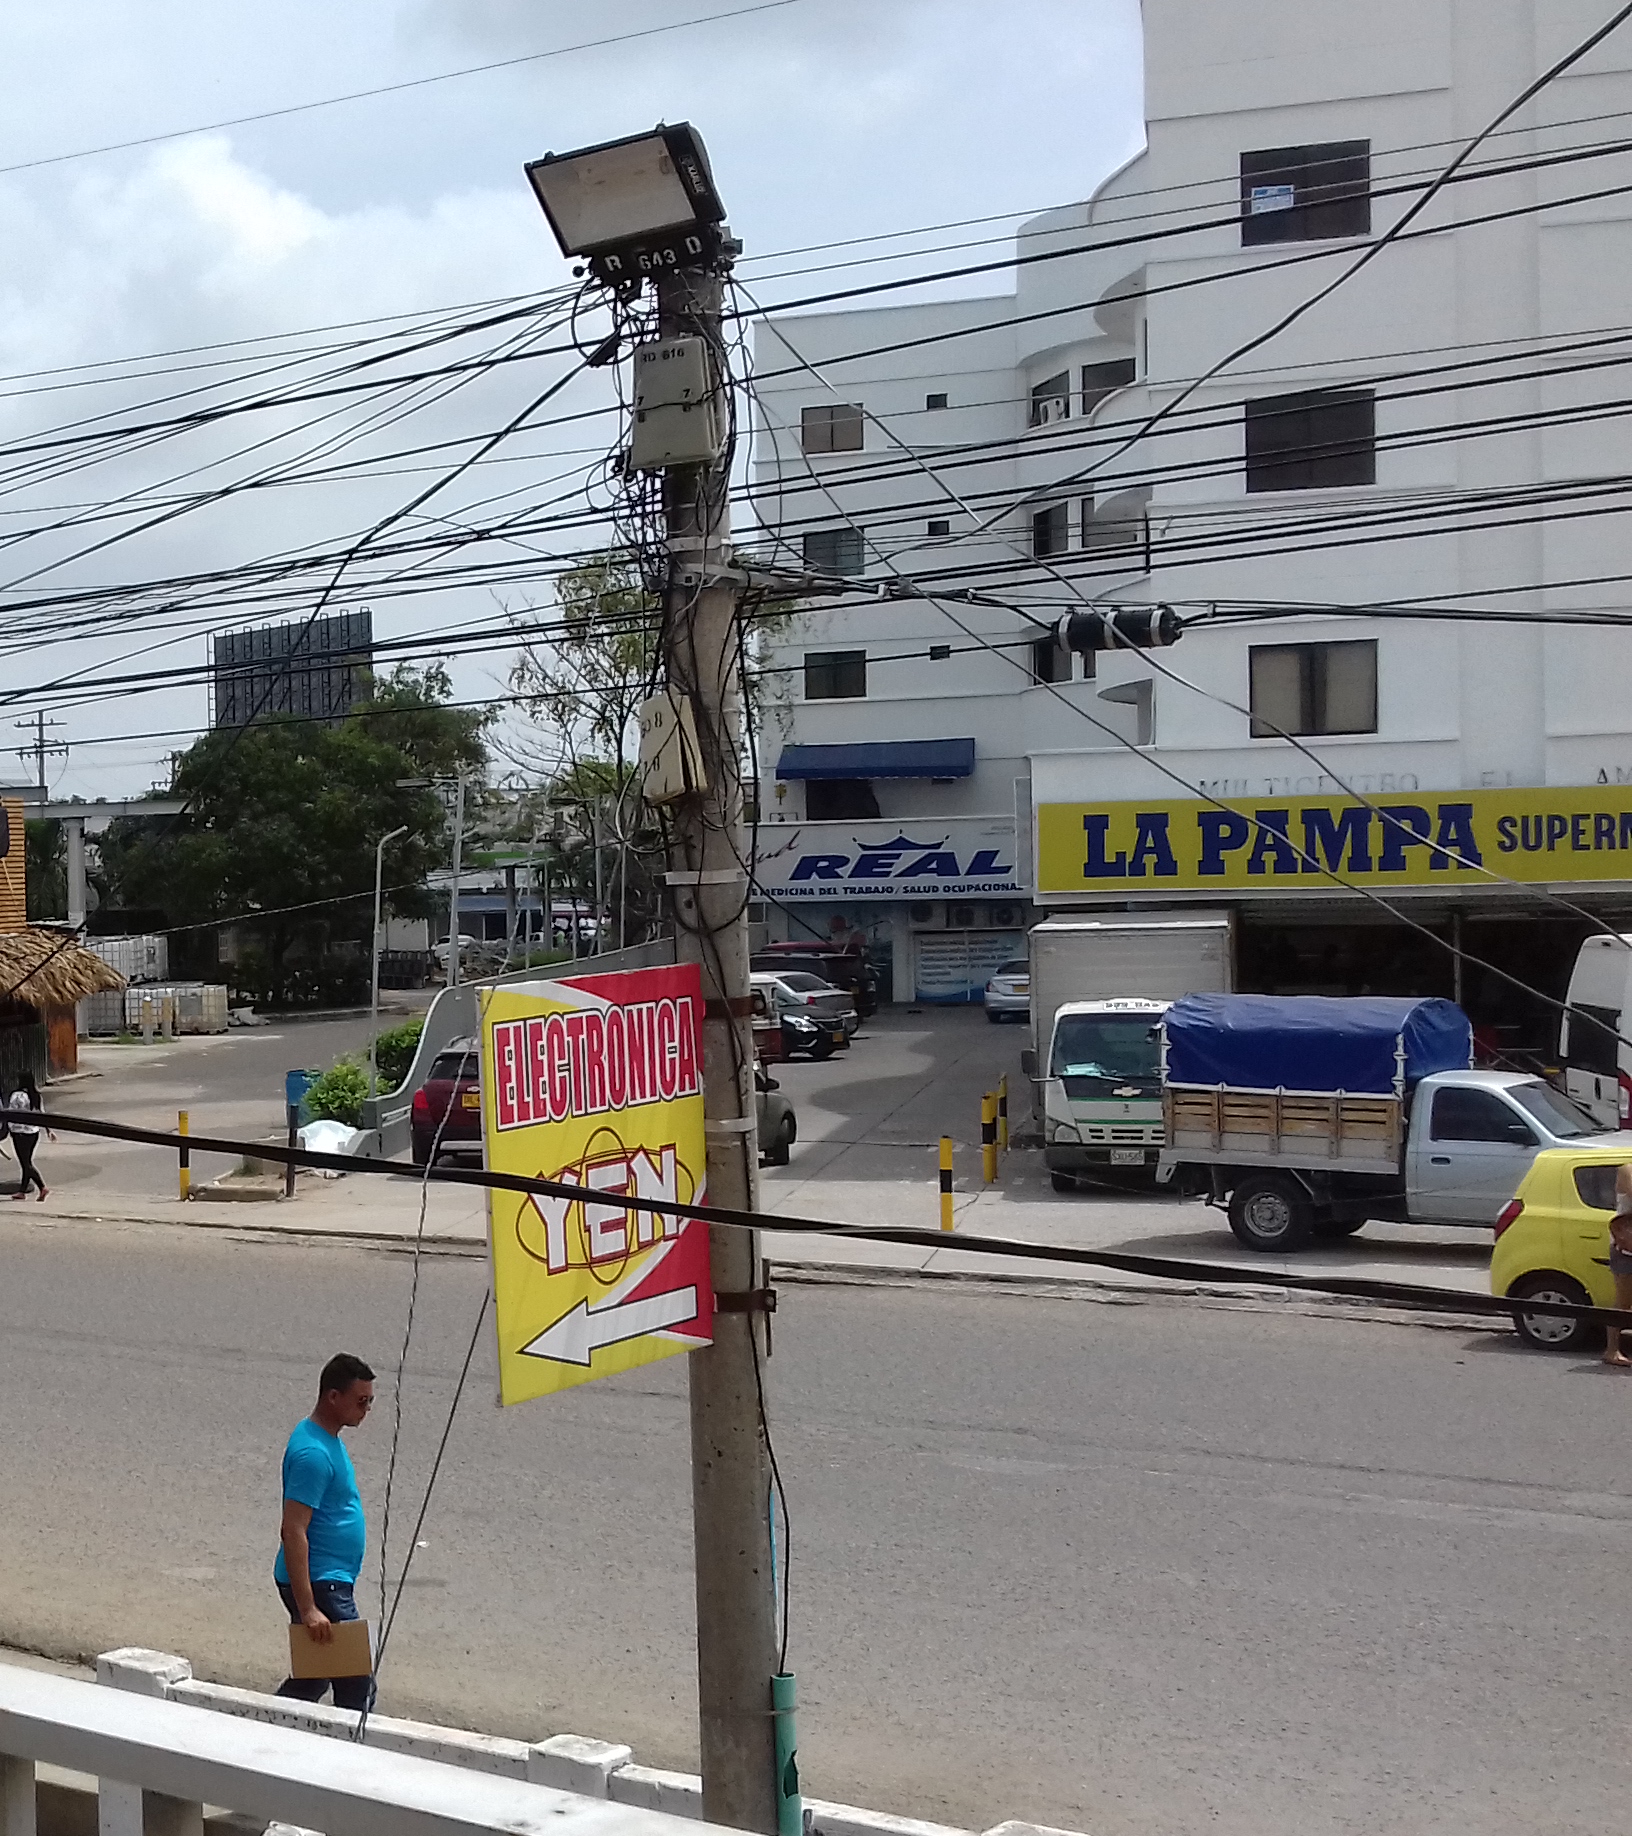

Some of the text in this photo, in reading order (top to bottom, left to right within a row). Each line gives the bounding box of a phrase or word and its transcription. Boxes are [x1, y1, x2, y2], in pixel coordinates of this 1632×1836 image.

[788, 850, 1013, 880] REAL
[1082, 813, 1179, 878] LA
[1197, 803, 1483, 876] PAMPA
[760, 887, 815, 897] MEDICINA
[818, 886, 838, 896] DEL
[902, 885, 939, 894] SALUD
[492, 996, 702, 1133] ELECTRONICA
[528, 1144, 680, 1275] YEN
